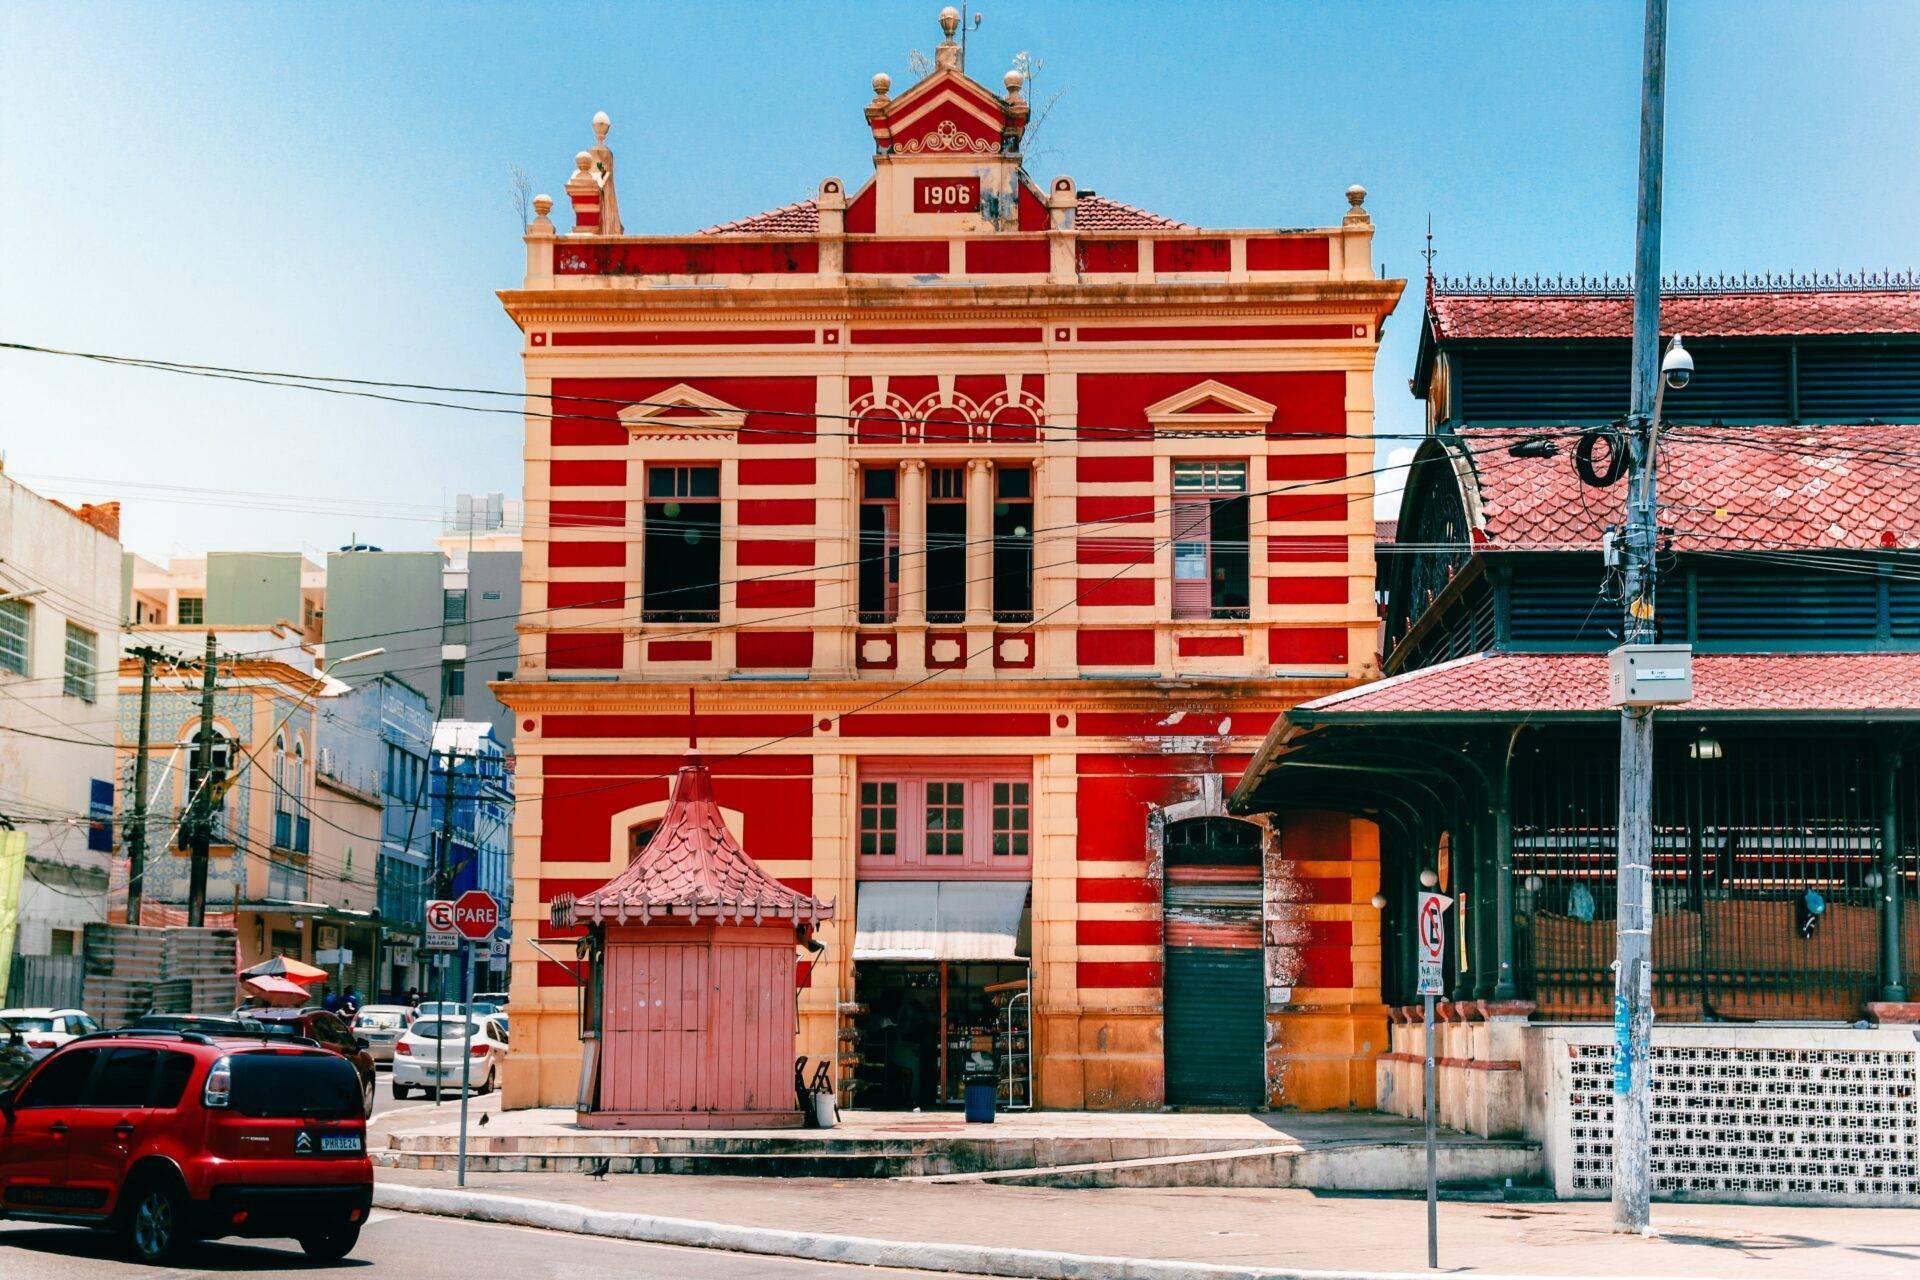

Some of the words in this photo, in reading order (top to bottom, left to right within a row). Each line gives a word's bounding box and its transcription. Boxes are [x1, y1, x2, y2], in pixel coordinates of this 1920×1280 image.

[924, 186, 970, 205] 1906
[456, 908, 495, 923] PARE
[1421, 966, 1431, 976] NA
